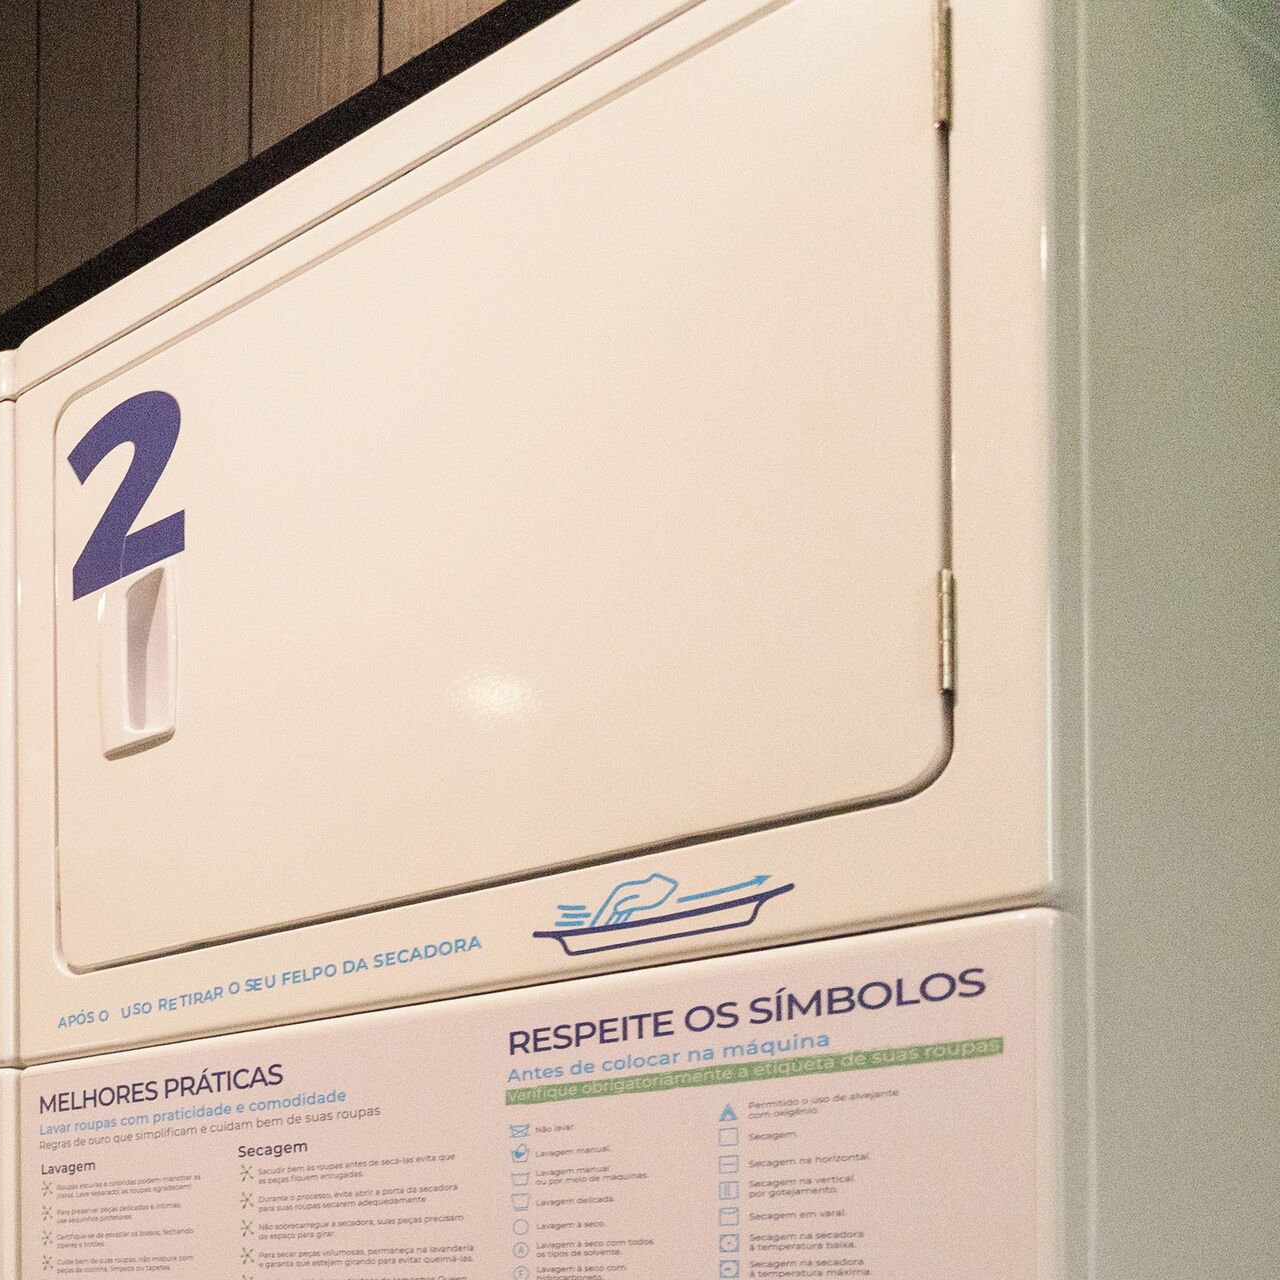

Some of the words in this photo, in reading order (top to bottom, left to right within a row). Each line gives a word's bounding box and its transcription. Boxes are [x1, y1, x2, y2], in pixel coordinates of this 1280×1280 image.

[67, 389, 185, 602] 2
[58, 1010, 94, 1028] APÓS
[99, 1009, 109, 1022] O
[121, 1002, 152, 1019] USO
[158, 987, 223, 1011] RETIRAR
[228, 981, 240, 995] O
[245, 975, 276, 992] SEU
[282, 964, 337, 984] FELPO
[343, 958, 368, 974] DA
[374, 937, 482, 967] SECADORA
[510, 1011, 674, 1053] RESPEITE
[685, 1002, 739, 1032] OS
[750, 969, 986, 1023] SÍMBOLOS
[507, 1066, 564, 1082] Antes
[570, 1060, 595, 1076] de
[602, 1053, 680, 1071] colocar
[688, 1048, 714, 1062] na
[723, 1035, 830, 1057] máquina
[507, 1084, 577, 1103] Verifique
[581, 1068, 734, 1097] obrigatoriamente
[739, 1068, 748, 1078] a
[753, 1057, 834, 1079] etiqueta
[841, 1054, 867, 1069] de
[871, 1051, 919, 1065] suas
[925, 1040, 999, 1062] roupas
[40, 1081, 158, 1112] MELHORES
[165, 1064, 283, 1097] PRÁTICAS
[39, 1140, 71, 1151] Regras
[74, 1138, 86, 1146] de
[88, 1136, 111, 1145] ouro
[113, 1134, 133, 1143] que
[135, 1127, 197, 1140] simplificam
[200, 1125, 207, 1134] e
[210, 1121, 253, 1133] cuidam
[256, 1118, 283, 1128] bem
[286, 1115, 302, 1125] de
[305, 1112, 333, 1123] suas
[336, 1107, 381, 1119] roupas
[40, 1124, 71, 1135] Lavar
[75, 1118, 117, 1131] roupas
[121, 1115, 149, 1126] com
[153, 1105, 232, 1124] praticidade
[236, 1104, 244, 1114] e
[249, 1091, 346, 1111] comodidade
[41, 1162, 96, 1175] Lavagem
[238, 1142, 308, 1158] Secagem
